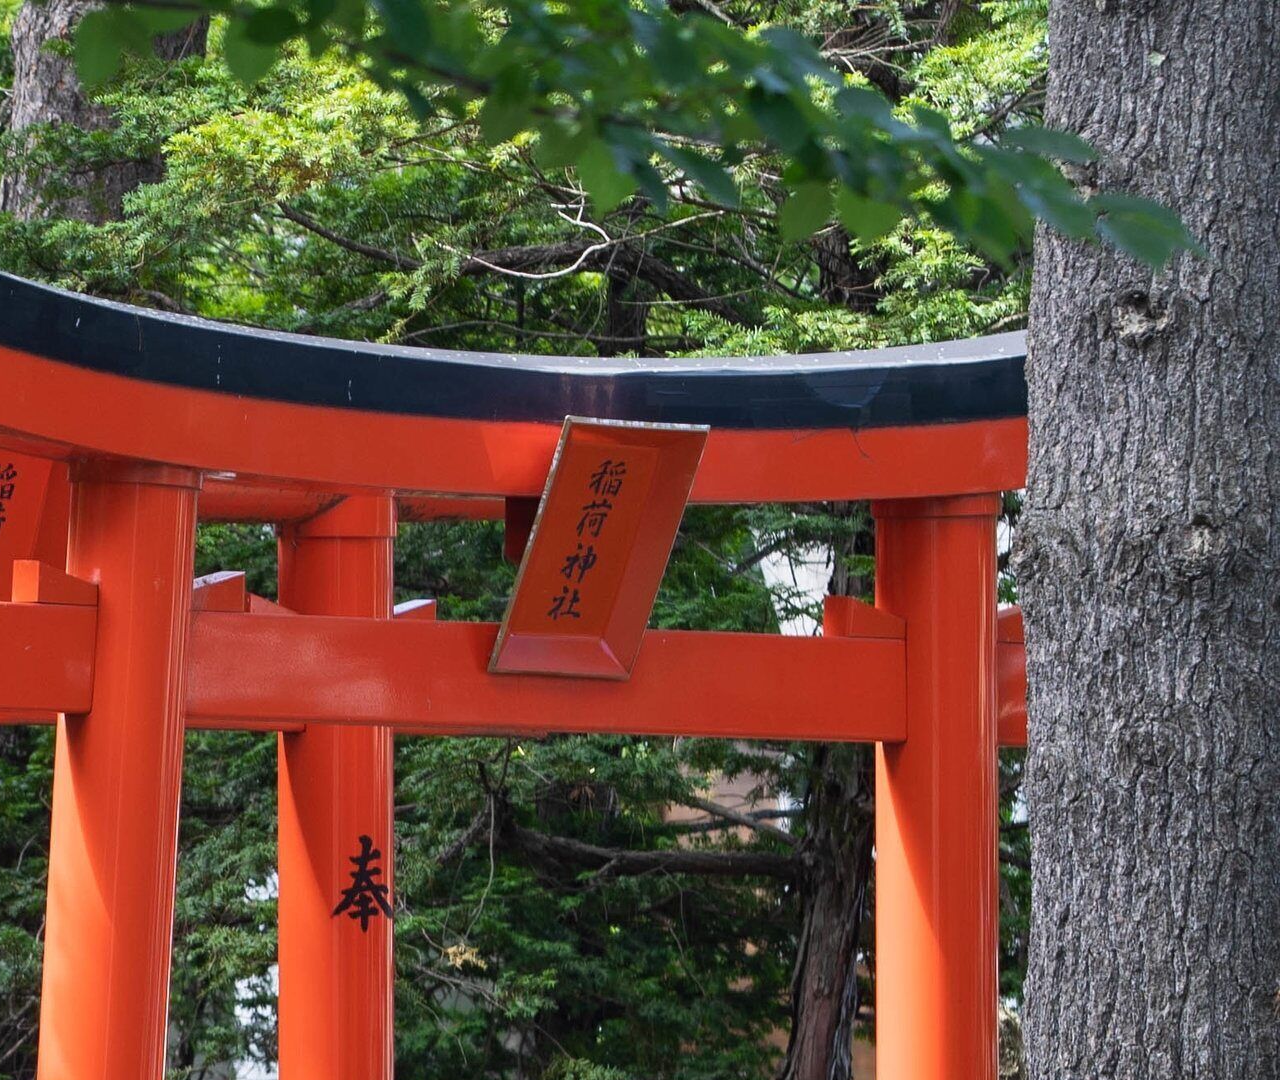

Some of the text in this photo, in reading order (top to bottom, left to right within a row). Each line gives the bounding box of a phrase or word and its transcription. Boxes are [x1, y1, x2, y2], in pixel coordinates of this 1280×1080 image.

[547, 459, 627, 621] 稲荷神社
[330, 834, 393, 933] 奉
